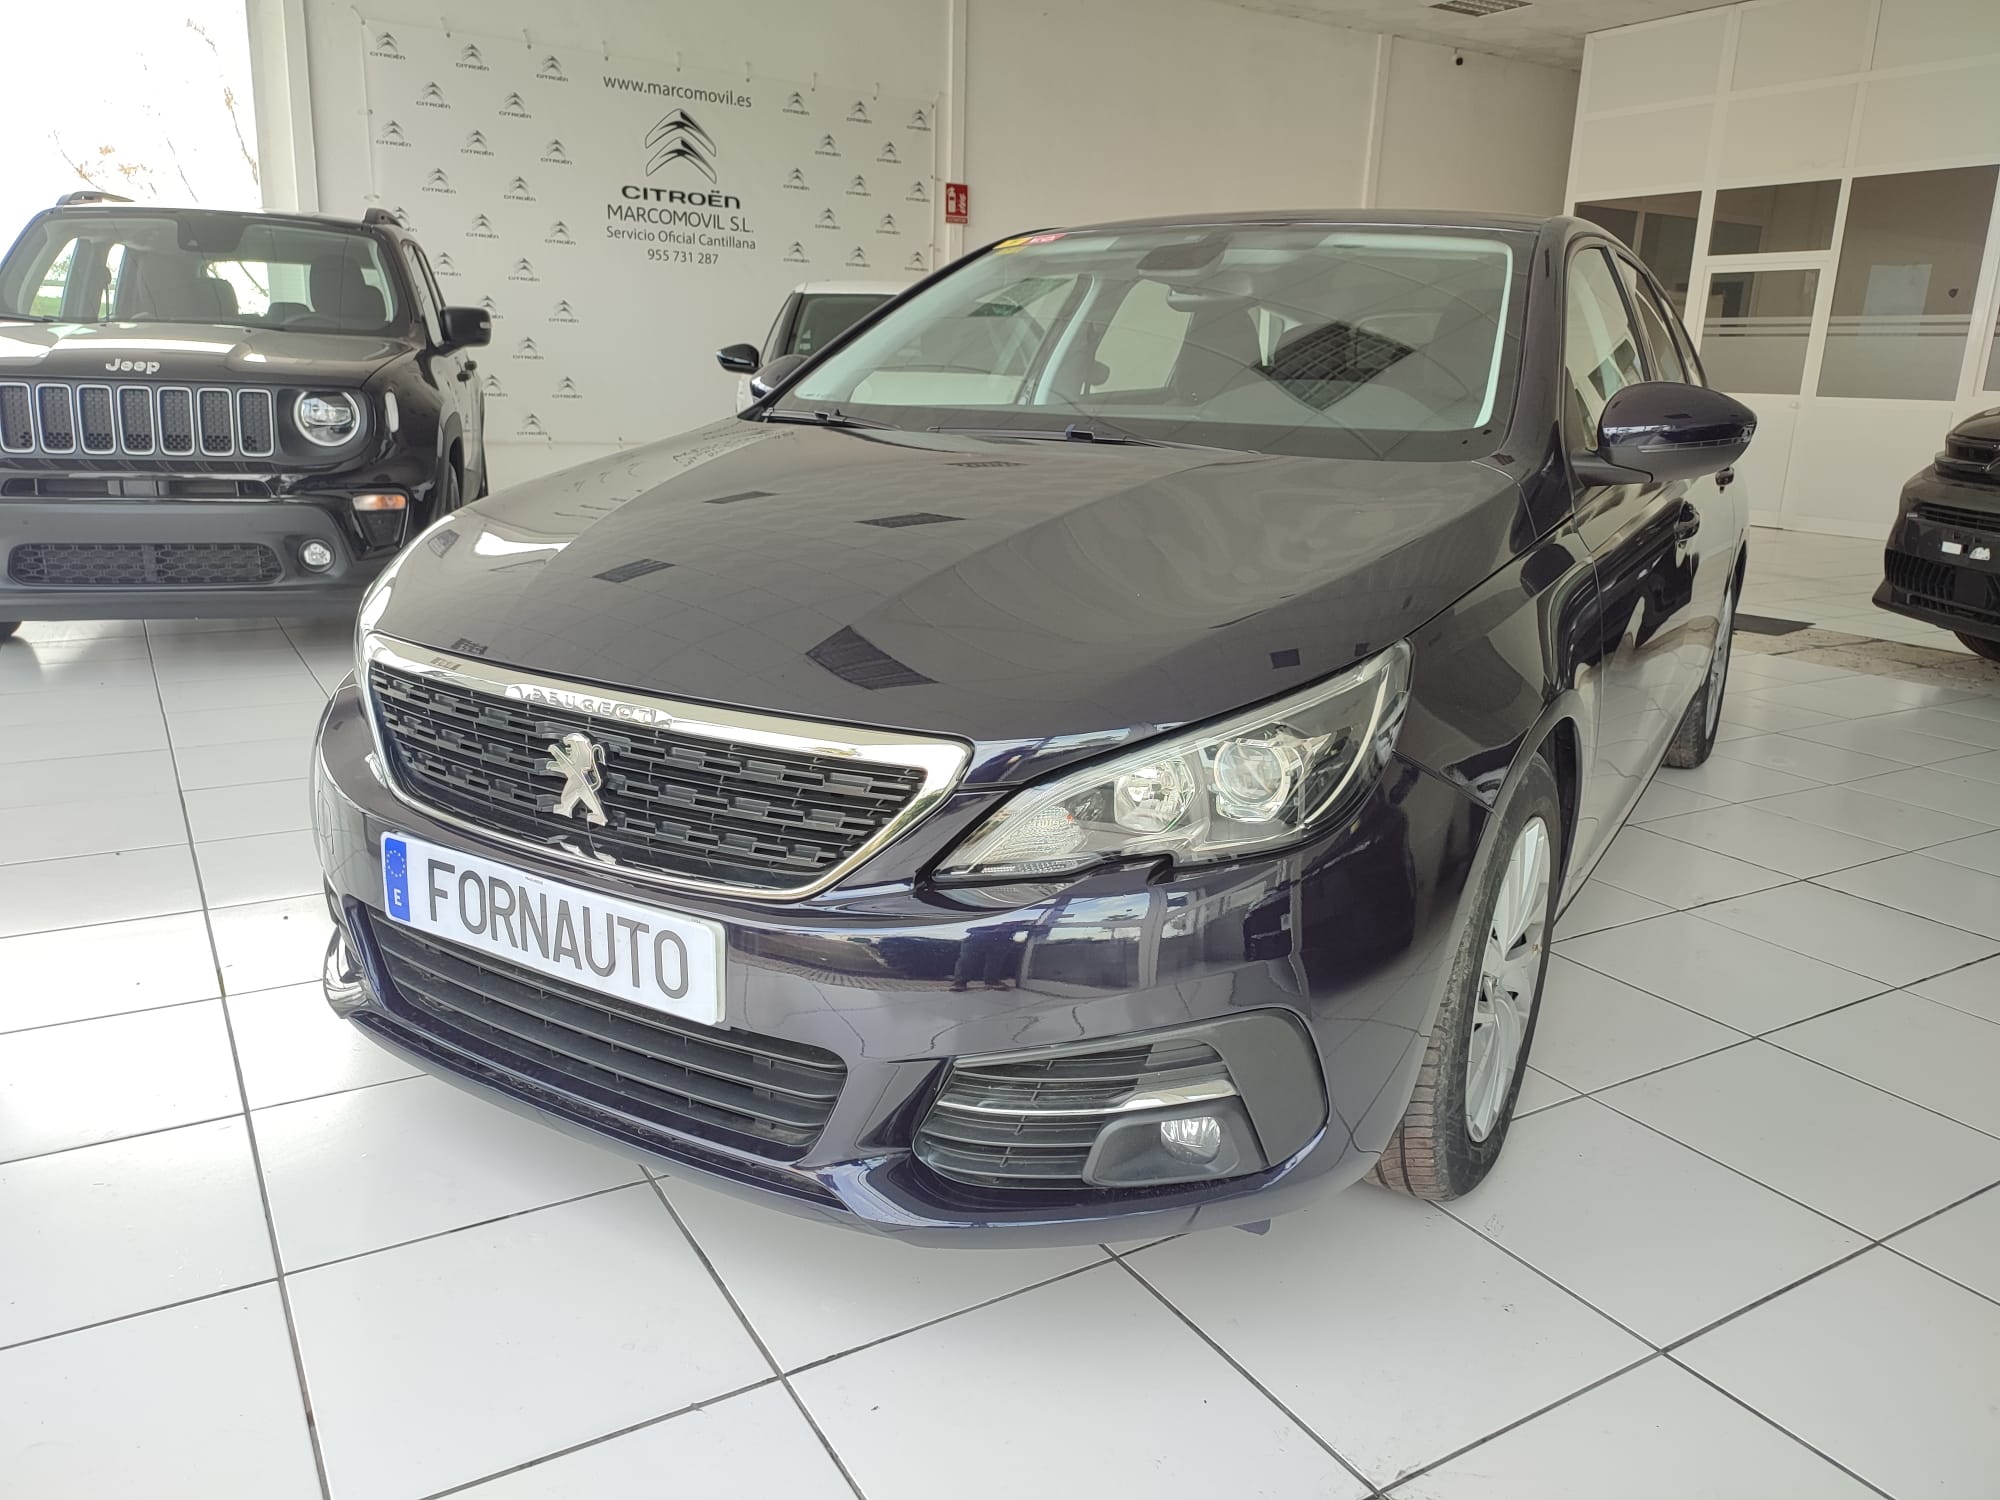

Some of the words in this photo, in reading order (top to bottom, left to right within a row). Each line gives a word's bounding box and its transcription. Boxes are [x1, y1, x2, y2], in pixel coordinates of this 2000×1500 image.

[603, 75, 752, 108] www.marcomovil.es
[607, 204, 725, 230] MARCOMOVIL
[730, 216, 754, 233] S.L.
[606, 226, 655, 242] Servicio
[658, 231, 695, 245] Oficial
[698, 233, 756, 250] Cantillana
[647, 248, 669, 261] 955
[673, 251, 693, 263] 731
[698, 252, 719, 265] 287
[105, 358, 160, 375] Jeep
[393, 889, 402, 907] E
[427, 858, 689, 999] FORNAUTO
